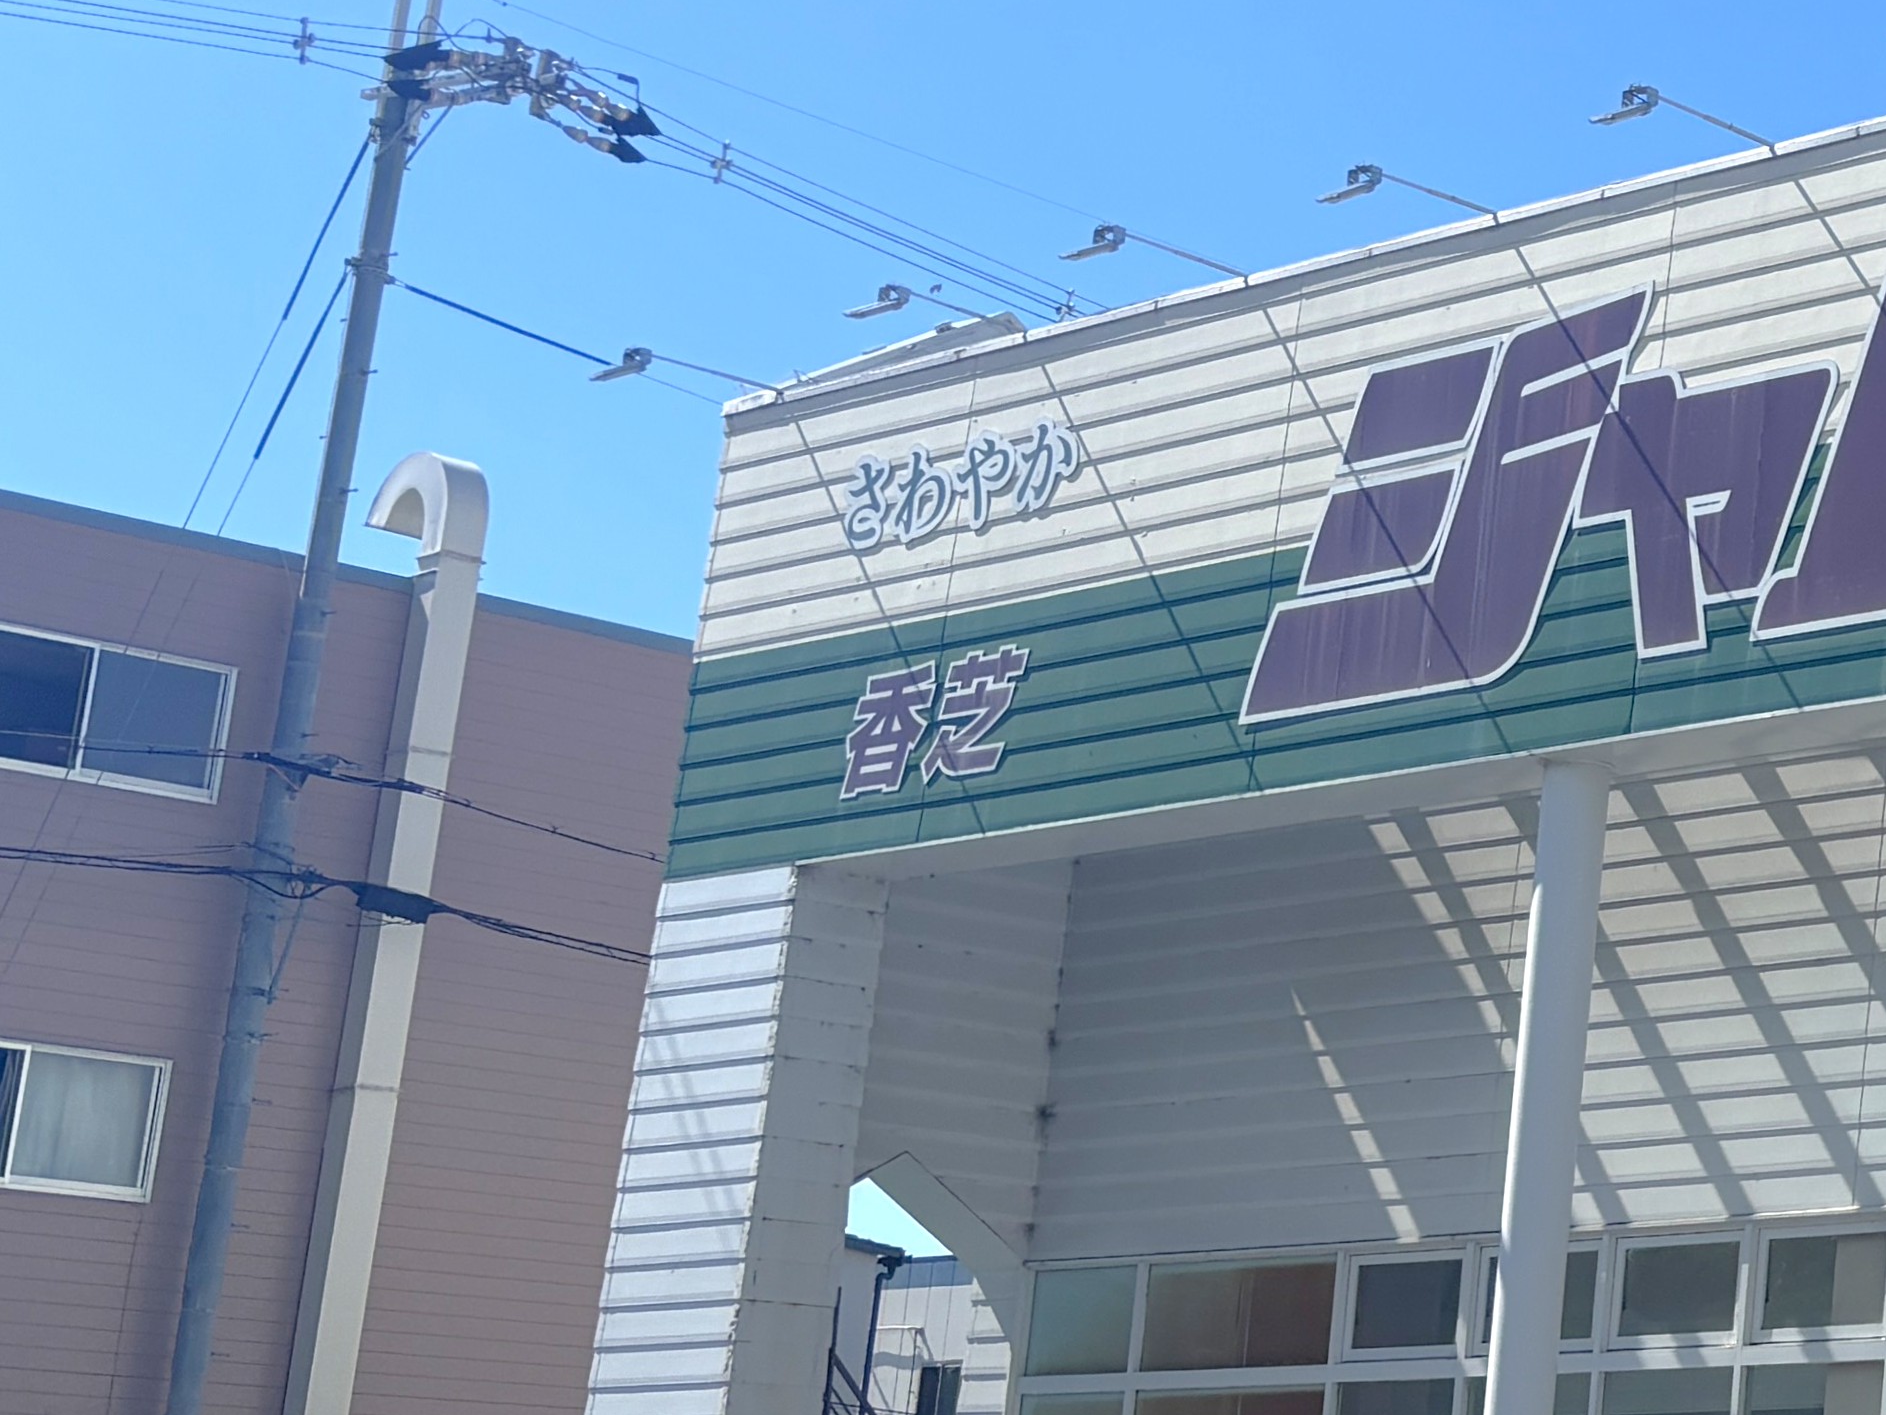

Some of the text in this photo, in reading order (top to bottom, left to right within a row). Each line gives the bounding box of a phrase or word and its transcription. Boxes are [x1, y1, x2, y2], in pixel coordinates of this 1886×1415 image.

[843, 416, 1080, 550] さわやか
[839, 643, 1030, 802] 香芝
